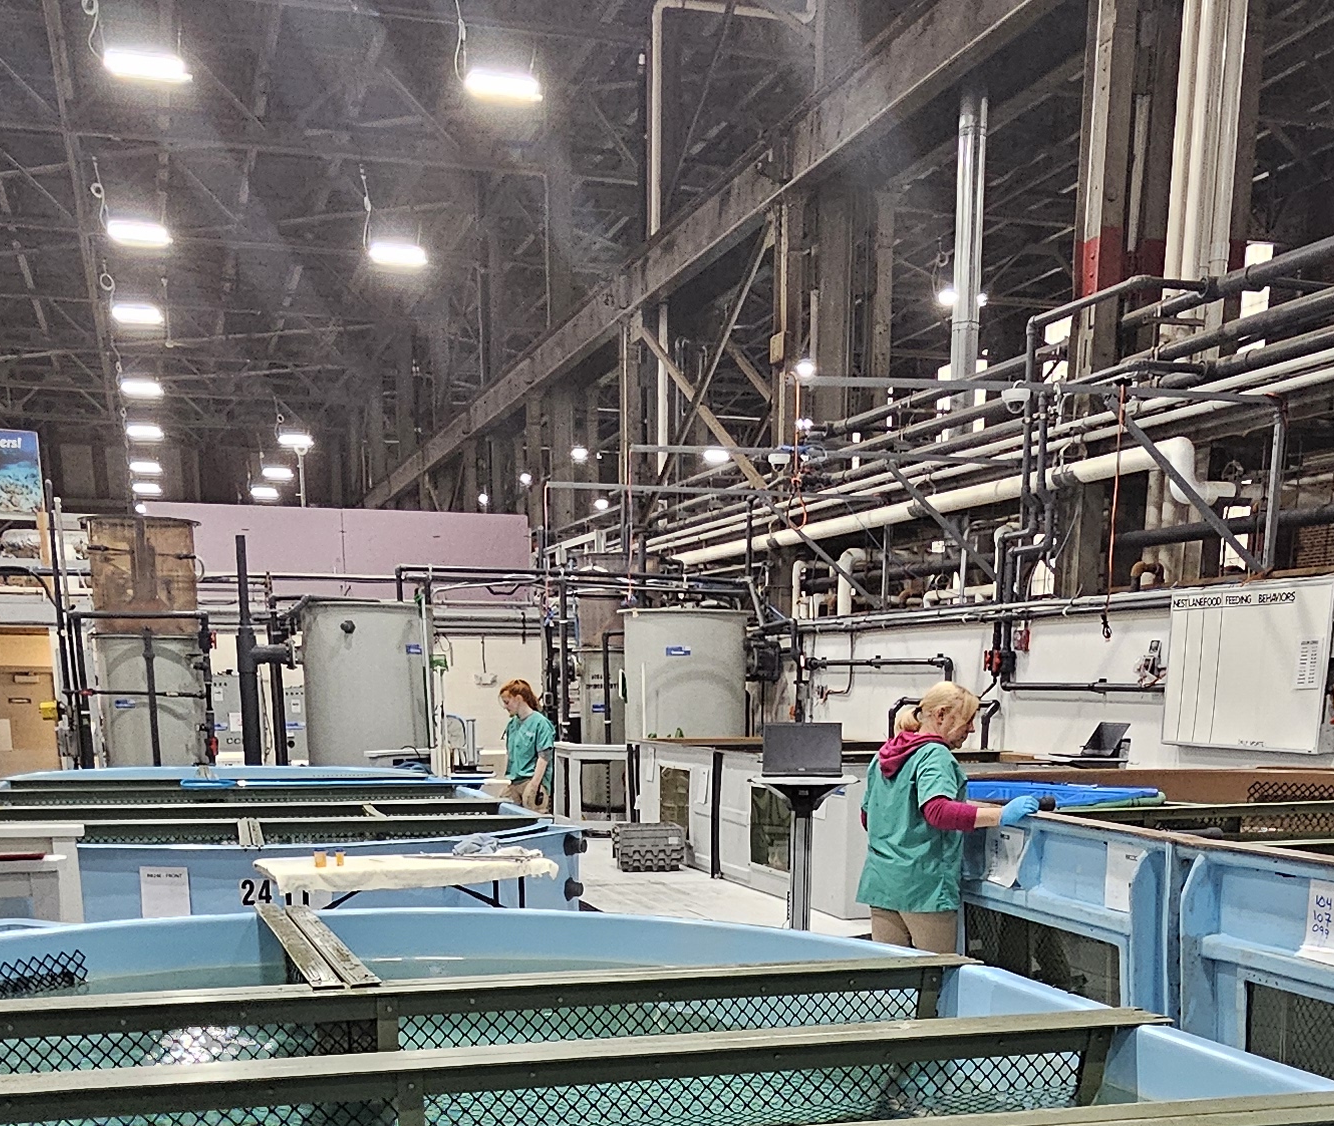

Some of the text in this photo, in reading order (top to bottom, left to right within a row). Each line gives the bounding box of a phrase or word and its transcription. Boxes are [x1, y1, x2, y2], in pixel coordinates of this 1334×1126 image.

[1188, 597, 1204, 607] LANE
[1204, 596, 1221, 606] FOOD
[1225, 594, 1252, 605] FEEDING
[1258, 591, 1296, 603] BEHAVIORS
[241, 879, 273, 906] 24
[1315, 894, 1332, 910] 104
[1313, 909, 1332, 927] 107
